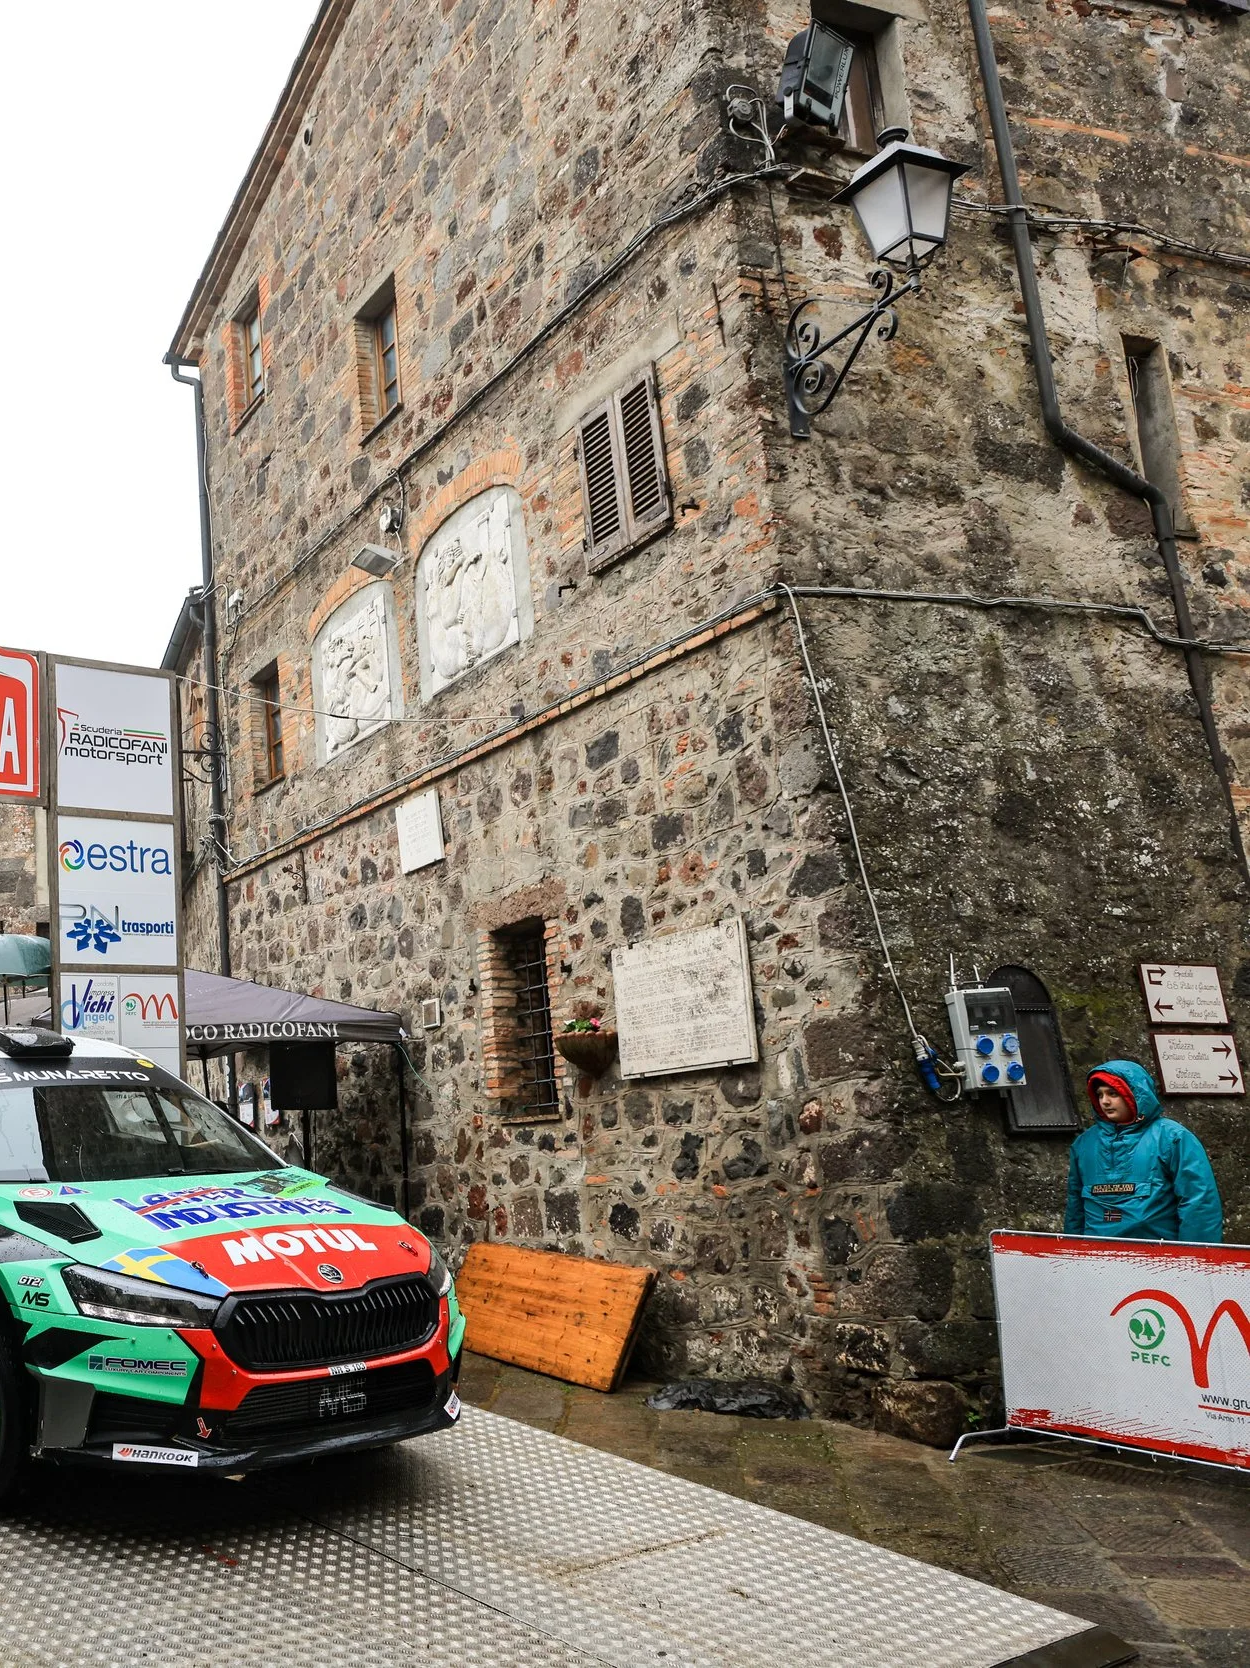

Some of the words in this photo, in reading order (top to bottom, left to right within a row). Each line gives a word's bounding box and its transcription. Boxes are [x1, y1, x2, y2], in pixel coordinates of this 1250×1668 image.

[81, 724, 122, 736] Scuderia
[70, 732, 168, 754] RADICOFANI
[65, 745, 163, 765] motorsport
[87, 840, 172, 875] estra
[122, 920, 174, 936] trasporti
[89, 989, 115, 997] impresa
[224, 1022, 340, 1040] RADICOFANI
[16, 1069, 150, 1083] MUNARETTO
[135, 1197, 354, 1231] INDUSTRIES
[221, 1228, 378, 1266] MOTUL
[21, 1290, 50, 1307] MS
[105, 1357, 186, 1371] FOMEC
[1131, 1351, 1171, 1367] PEFC
[330, 1365, 343, 1376] NR
[352, 1362, 366, 1372] 103
[1205, 1411, 1217, 1420] Via
[1218, 1414, 1235, 1424] Arno
